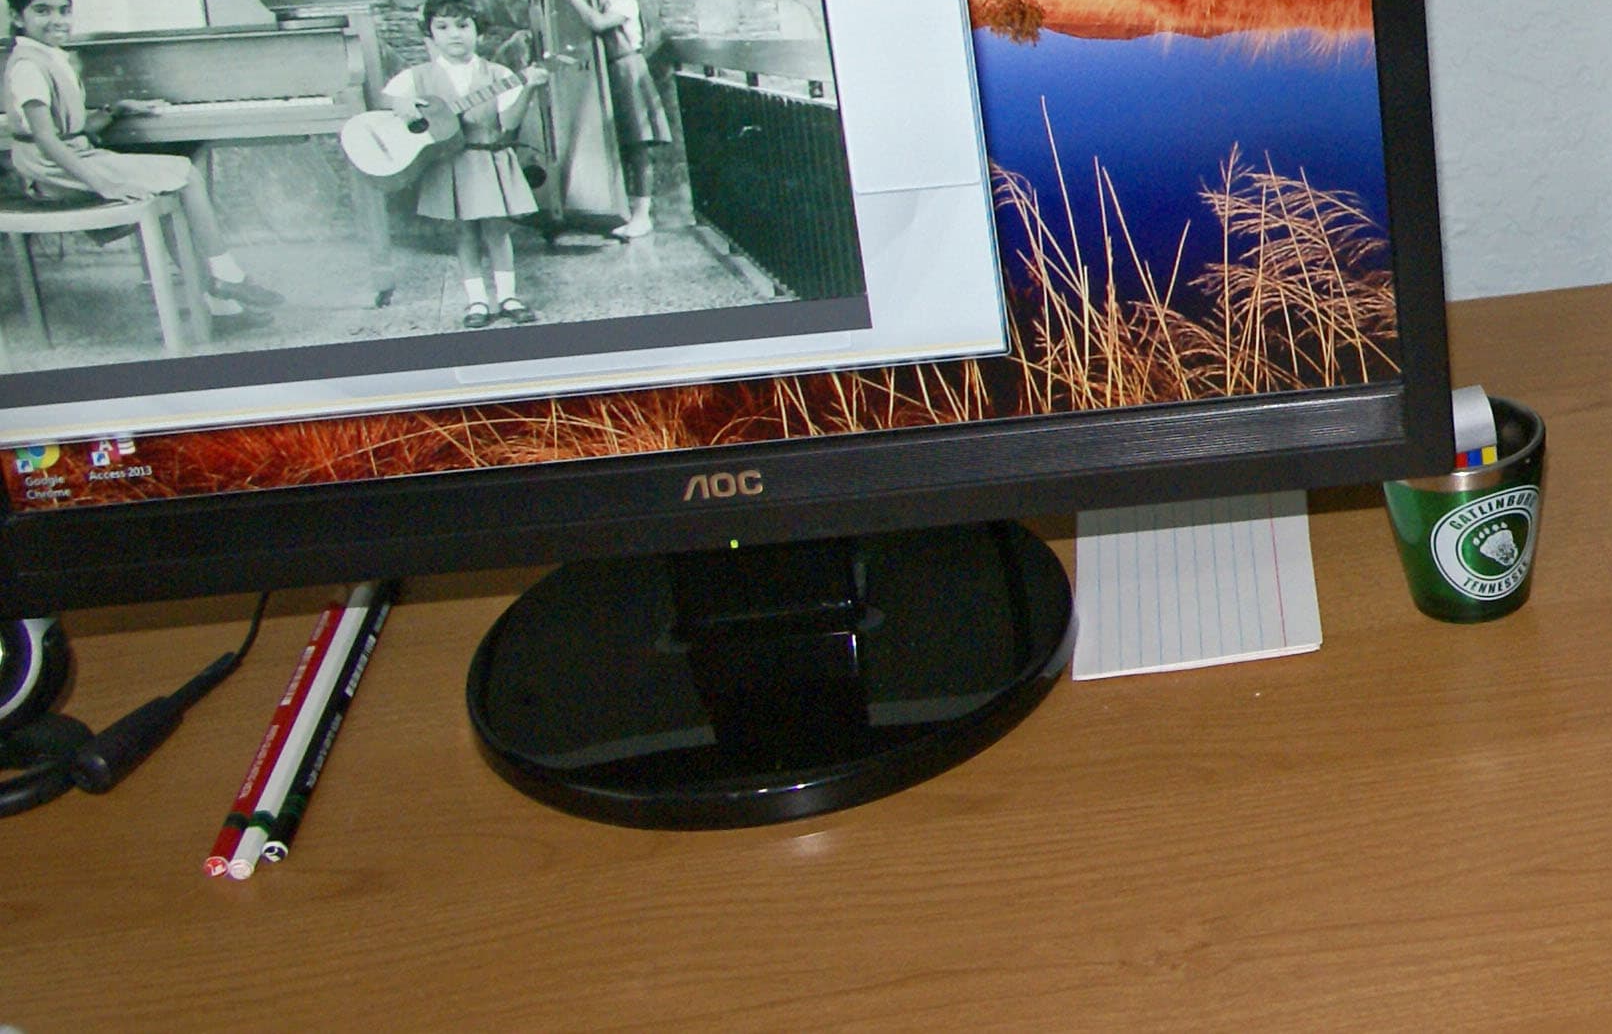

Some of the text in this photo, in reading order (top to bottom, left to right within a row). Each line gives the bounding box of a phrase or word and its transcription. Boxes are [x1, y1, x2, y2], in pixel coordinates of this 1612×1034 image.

[89, 465, 153, 481] Access 2013
[25, 475, 65, 489] Google
[683, 469, 763, 501] AOC
[26, 488, 72, 500] Chrome
